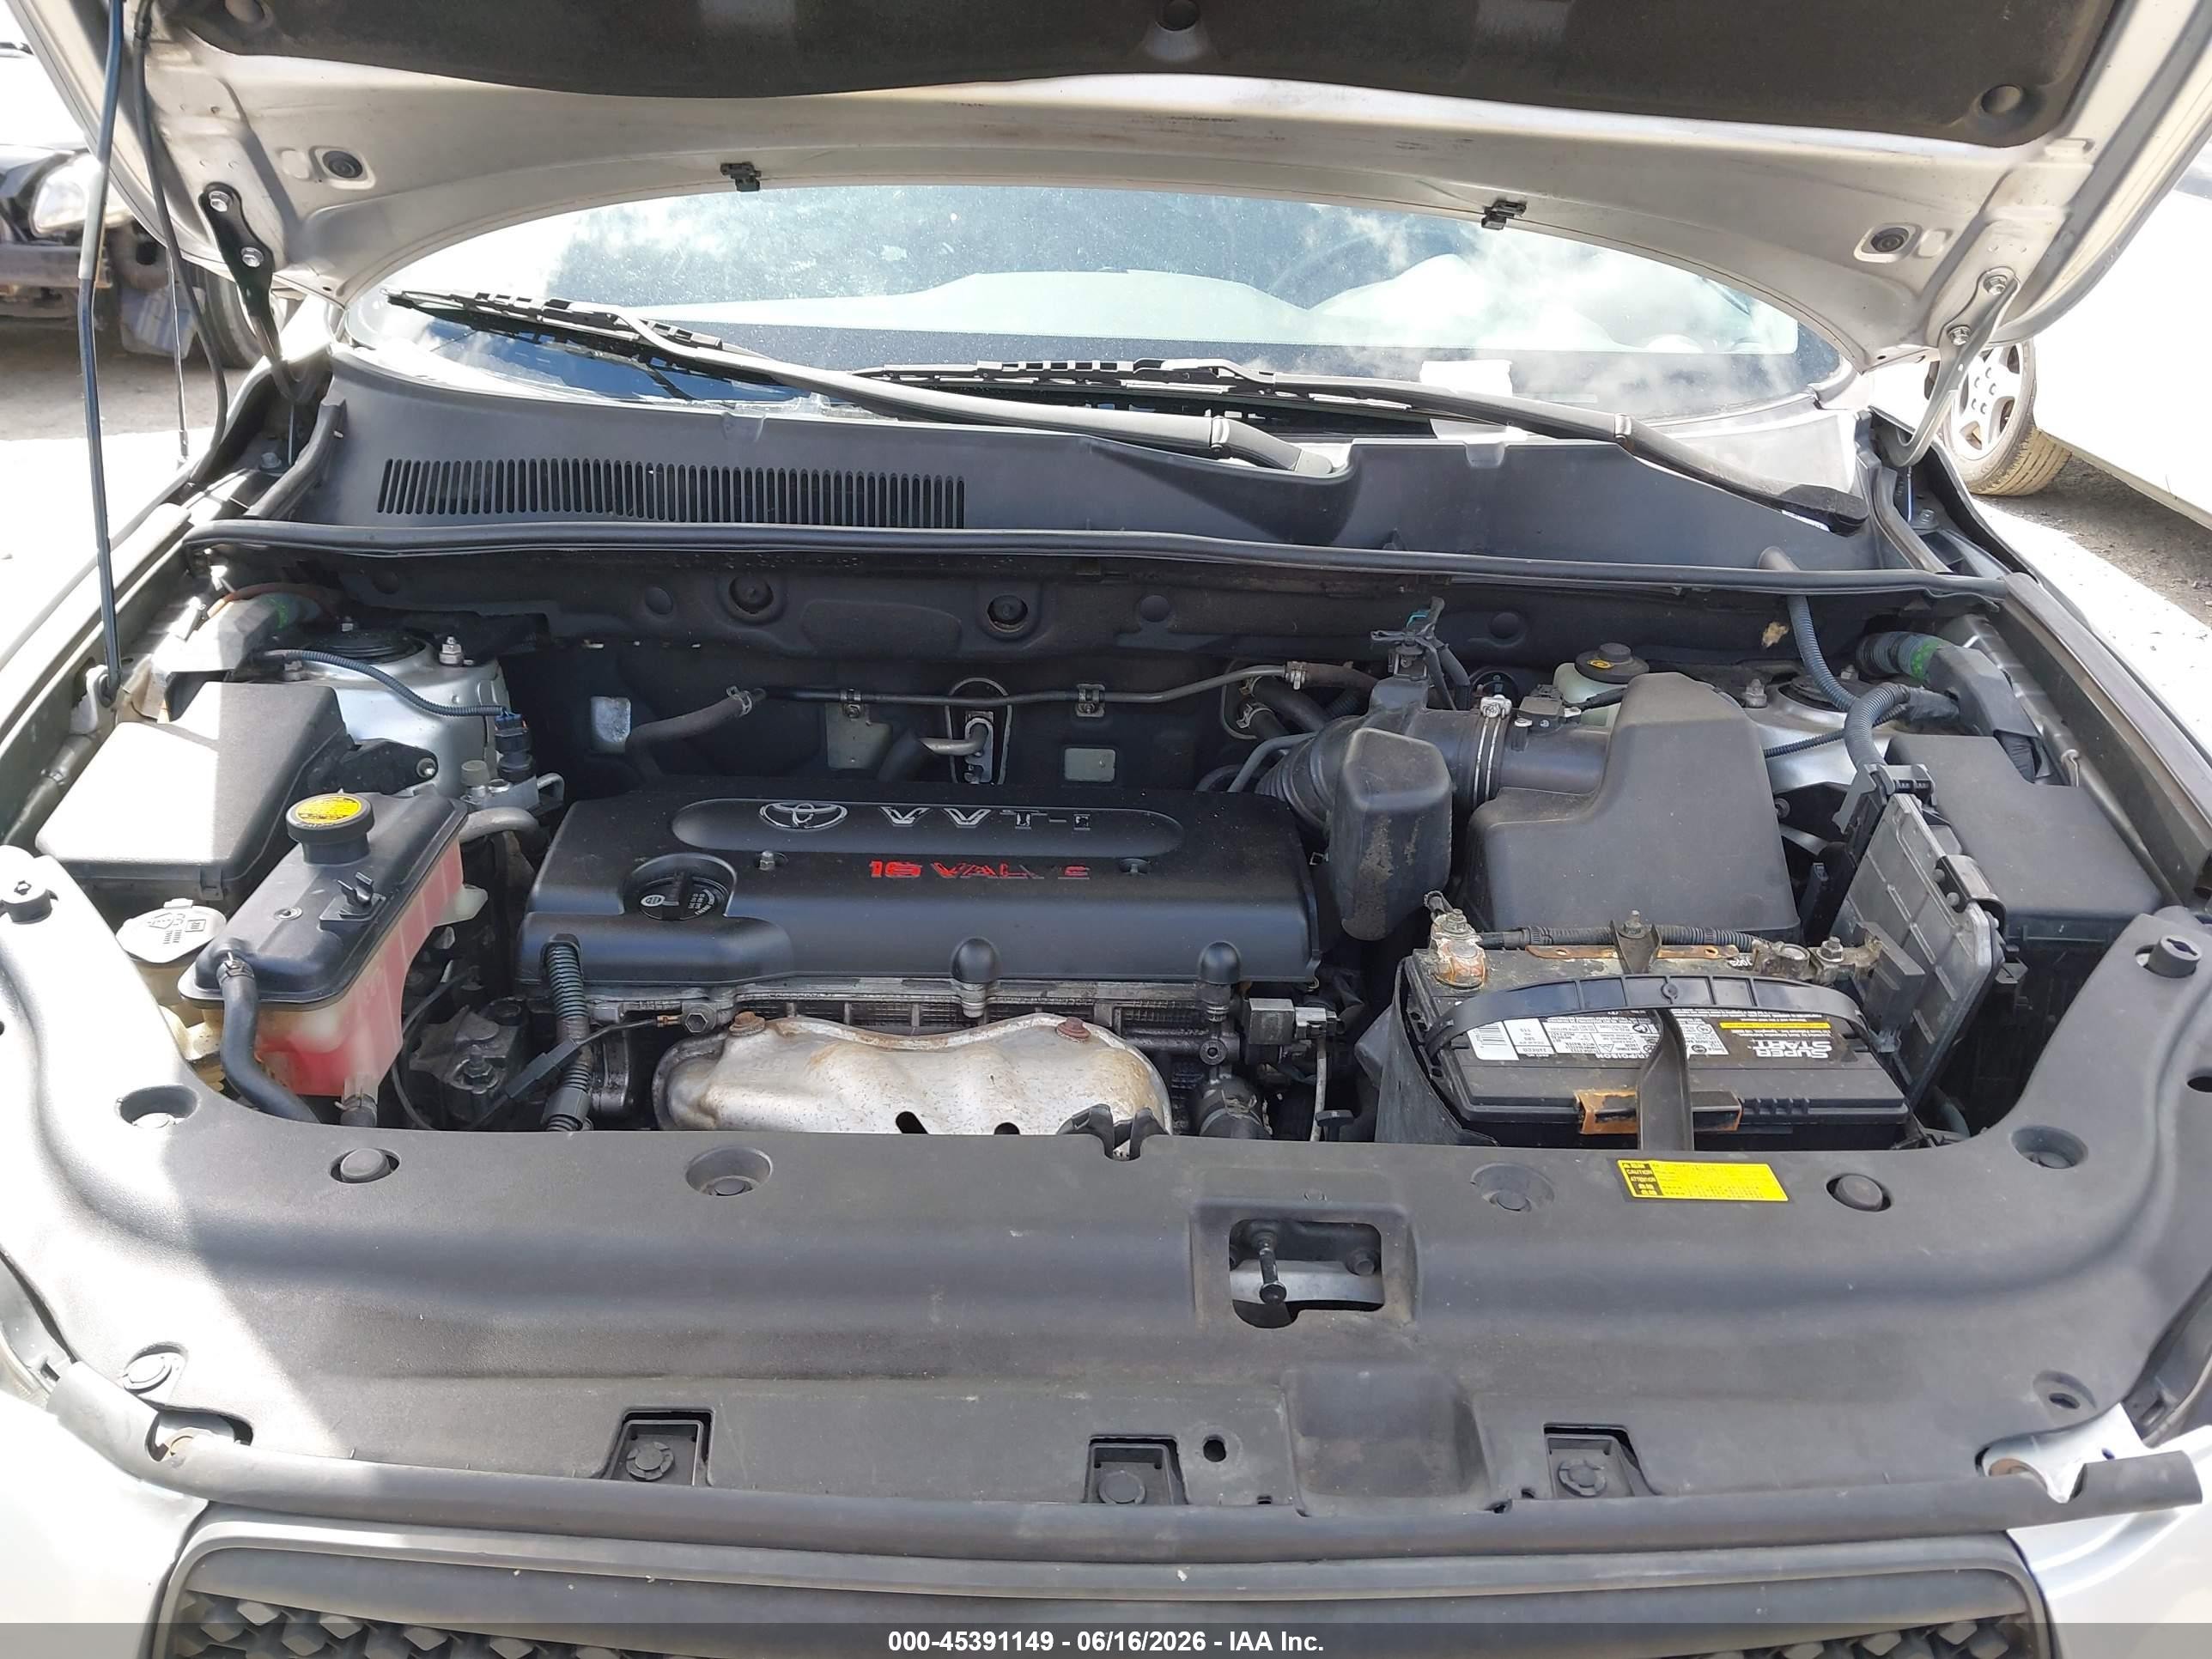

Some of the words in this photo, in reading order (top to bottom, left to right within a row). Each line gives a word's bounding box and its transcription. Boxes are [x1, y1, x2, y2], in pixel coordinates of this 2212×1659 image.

[869, 860, 922, 878] 16
[1752, 1040, 1832, 1051] START
[1755, 1048, 1829, 1059] SUPER
